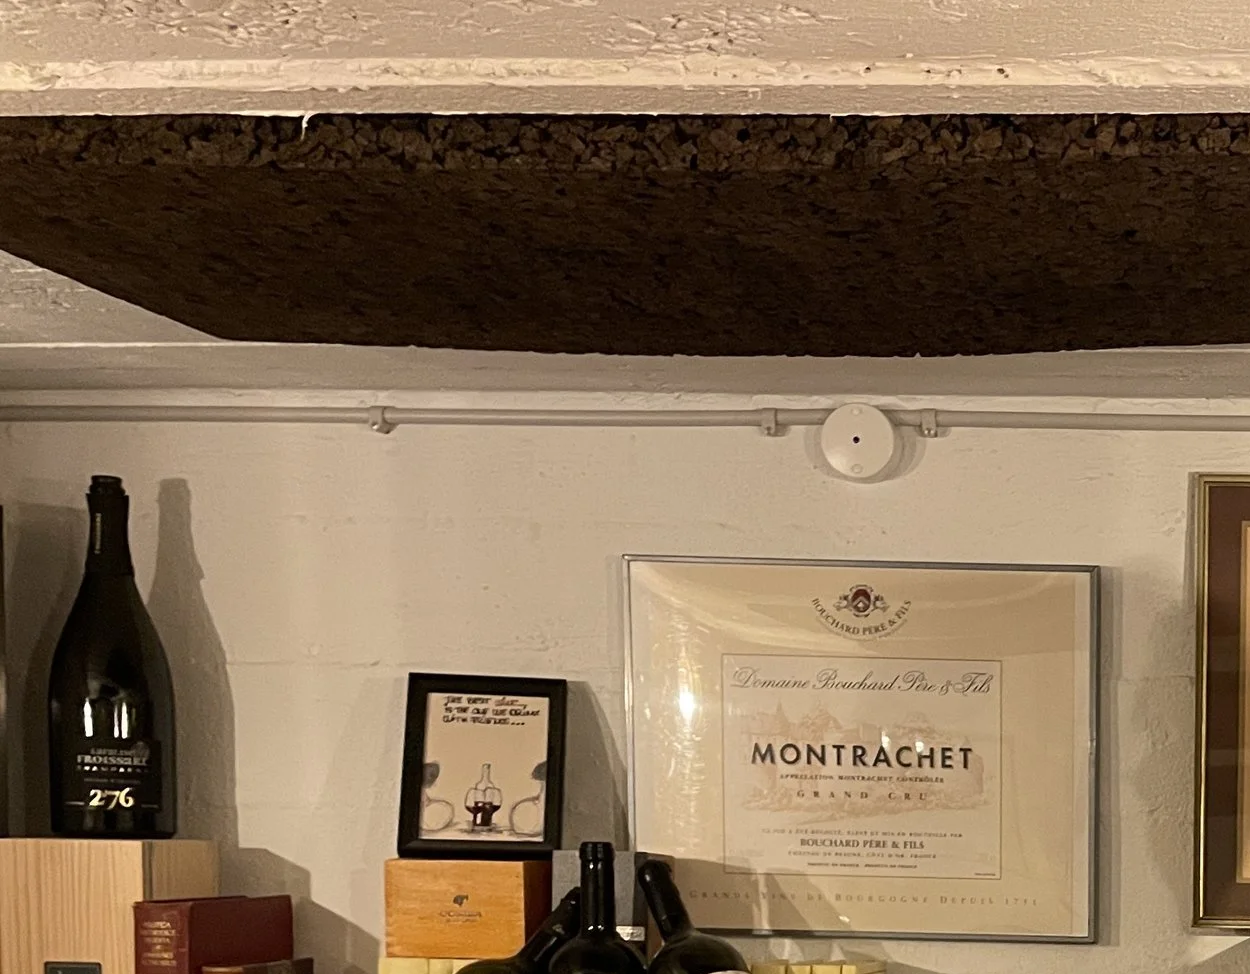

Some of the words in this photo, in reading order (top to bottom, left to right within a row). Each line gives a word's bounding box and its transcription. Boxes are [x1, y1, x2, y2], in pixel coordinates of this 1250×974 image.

[811, 598, 860, 635] BOUCHARD
[888, 619, 896, 627] &
[898, 600, 912, 620] FILS
[730, 666, 810, 690] Domaine
[813, 667, 900, 691] Bouchard
[898, 670, 937, 693] Père
[939, 681, 952, 696] &
[953, 671, 994, 696] Fils
[752, 742, 973, 770] MONTRACHET
[88, 787, 134, 810] 276
[797, 790, 869, 799] GRAND
[888, 791, 930, 801] CRU
[800, 838, 860, 849] BOUCHARD
[862, 838, 887, 849] PÈRE
[891, 840, 900, 849] &
[903, 840, 925, 850] FILS
